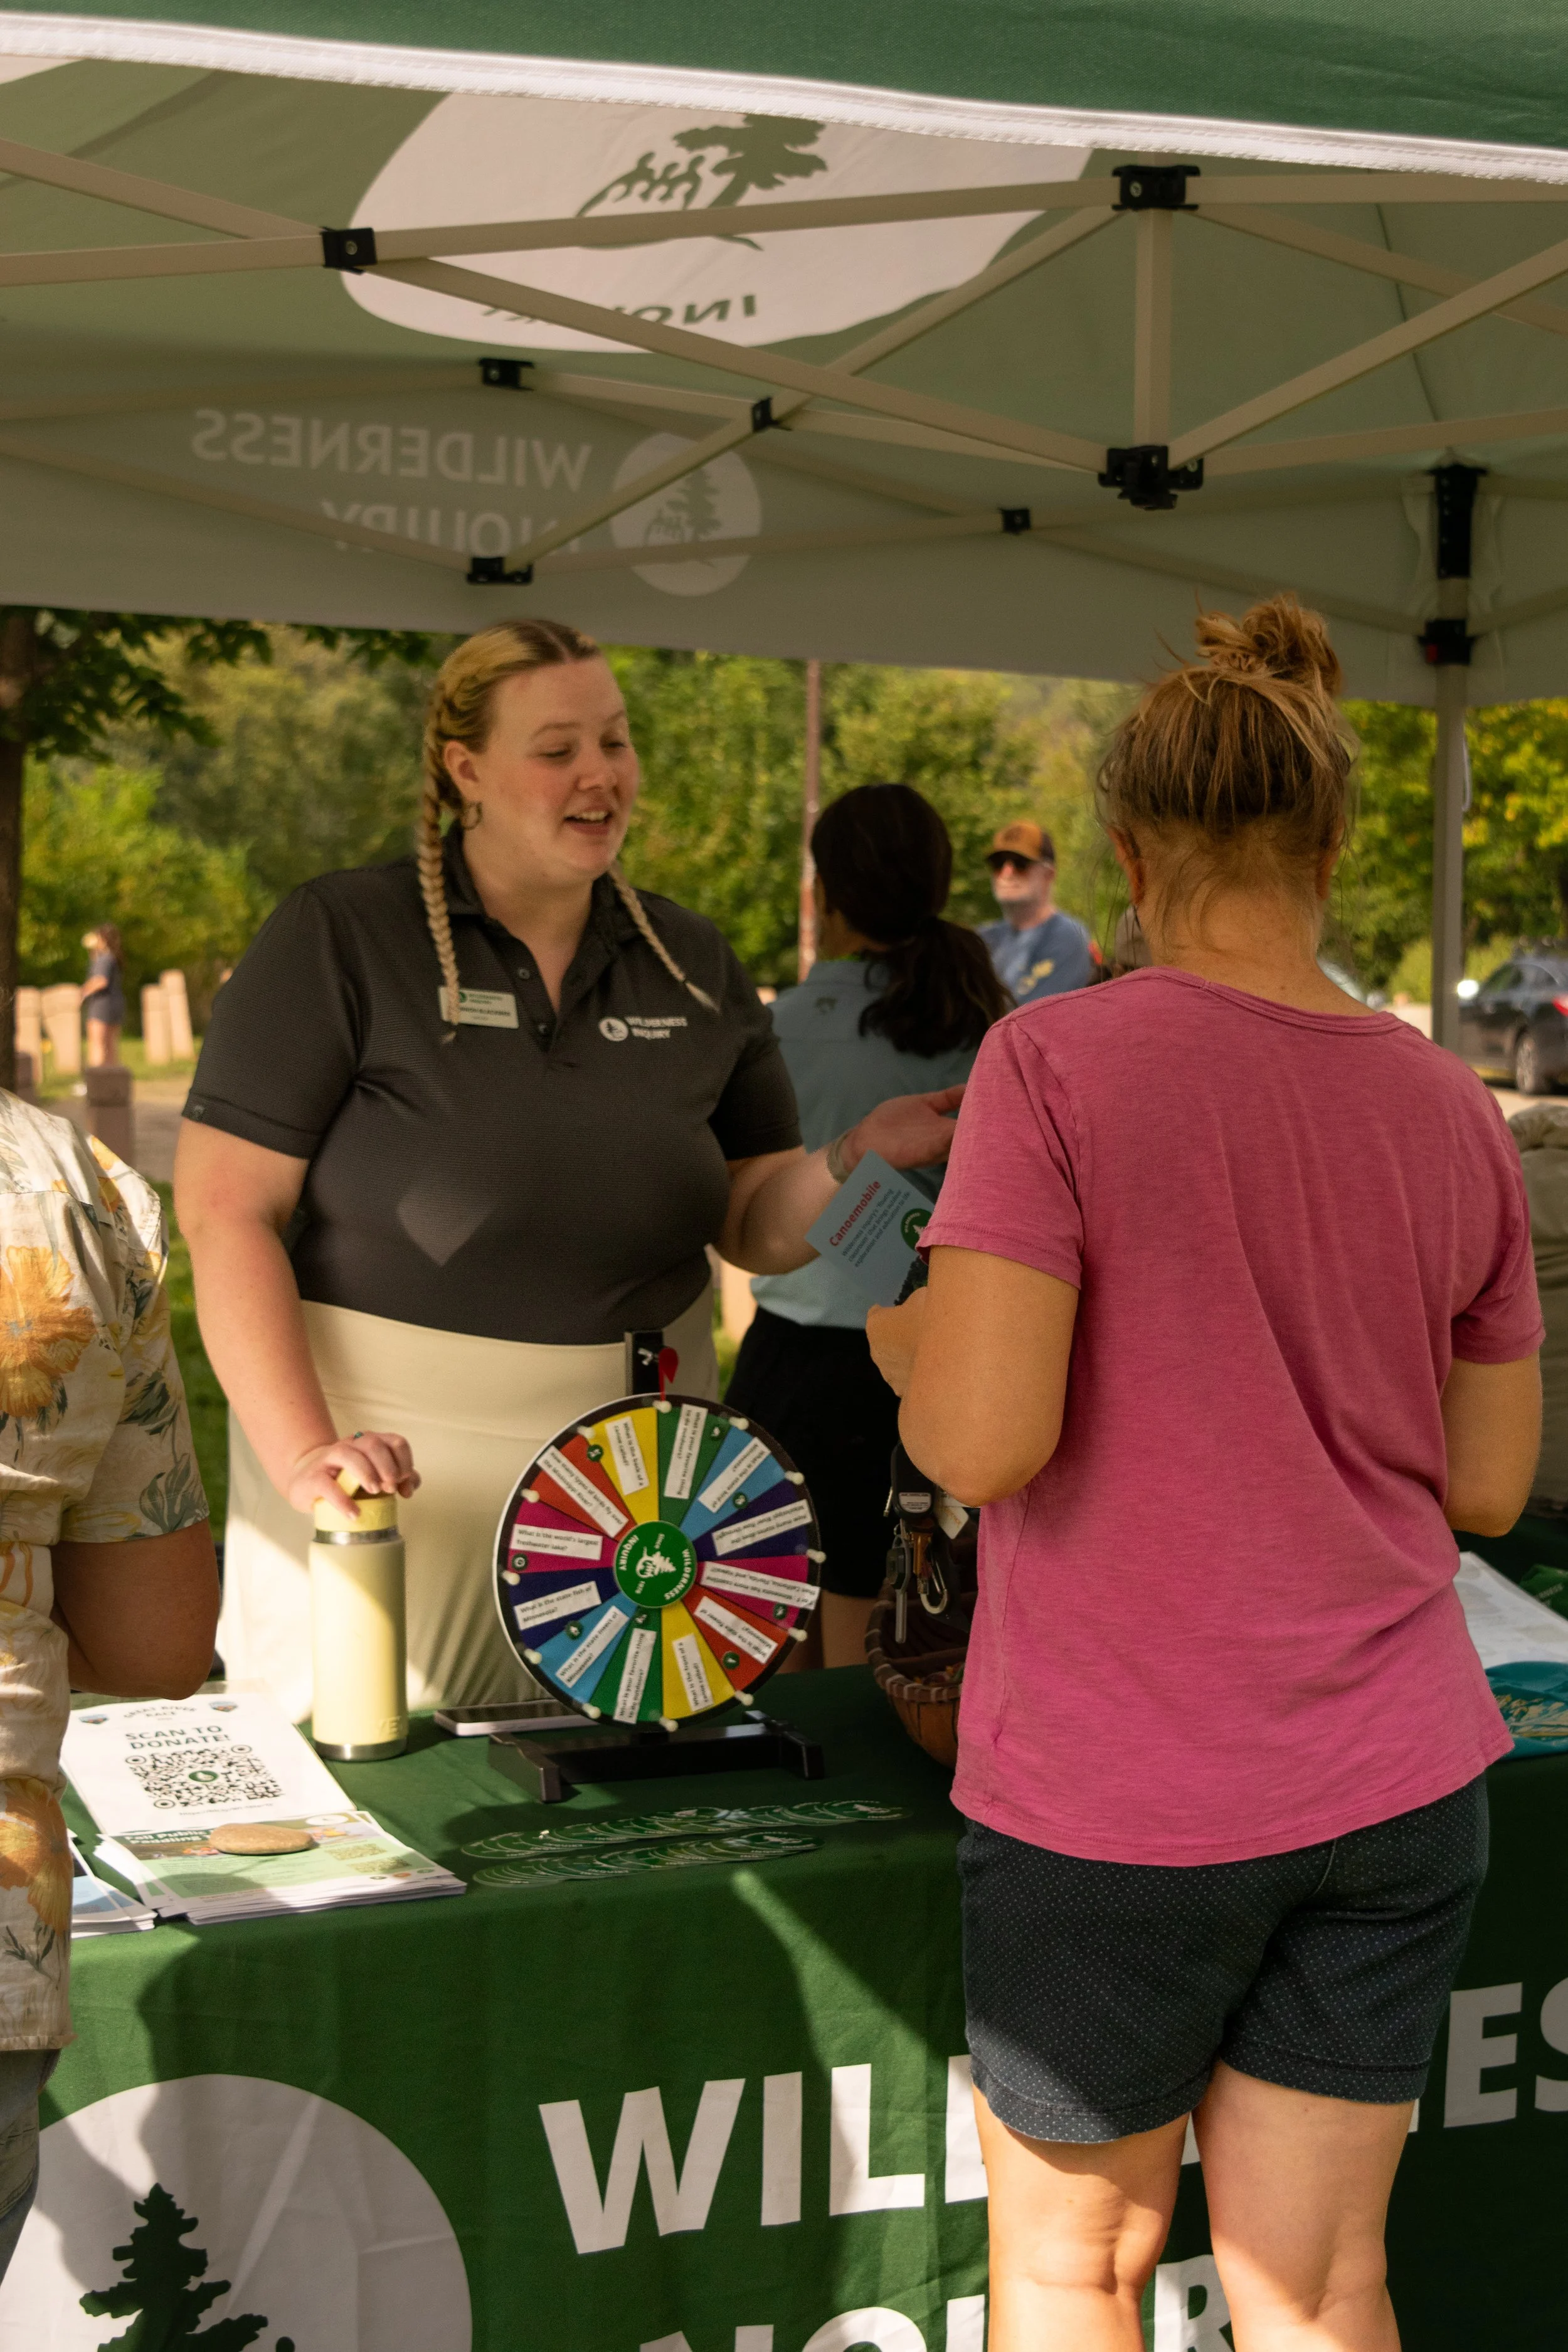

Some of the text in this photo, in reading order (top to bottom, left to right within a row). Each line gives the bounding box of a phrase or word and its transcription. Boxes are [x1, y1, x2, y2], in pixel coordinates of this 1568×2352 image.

[828, 1179, 880, 1246] Canoemobile
[619, 1535, 639, 1571] INQUIRY
[664, 1549, 692, 1600] WILDERNESS
[125, 1725, 223, 1740] SCAN TO
[130, 1734, 230, 1749] DONATE!
[156, 1831, 206, 1839] Public
